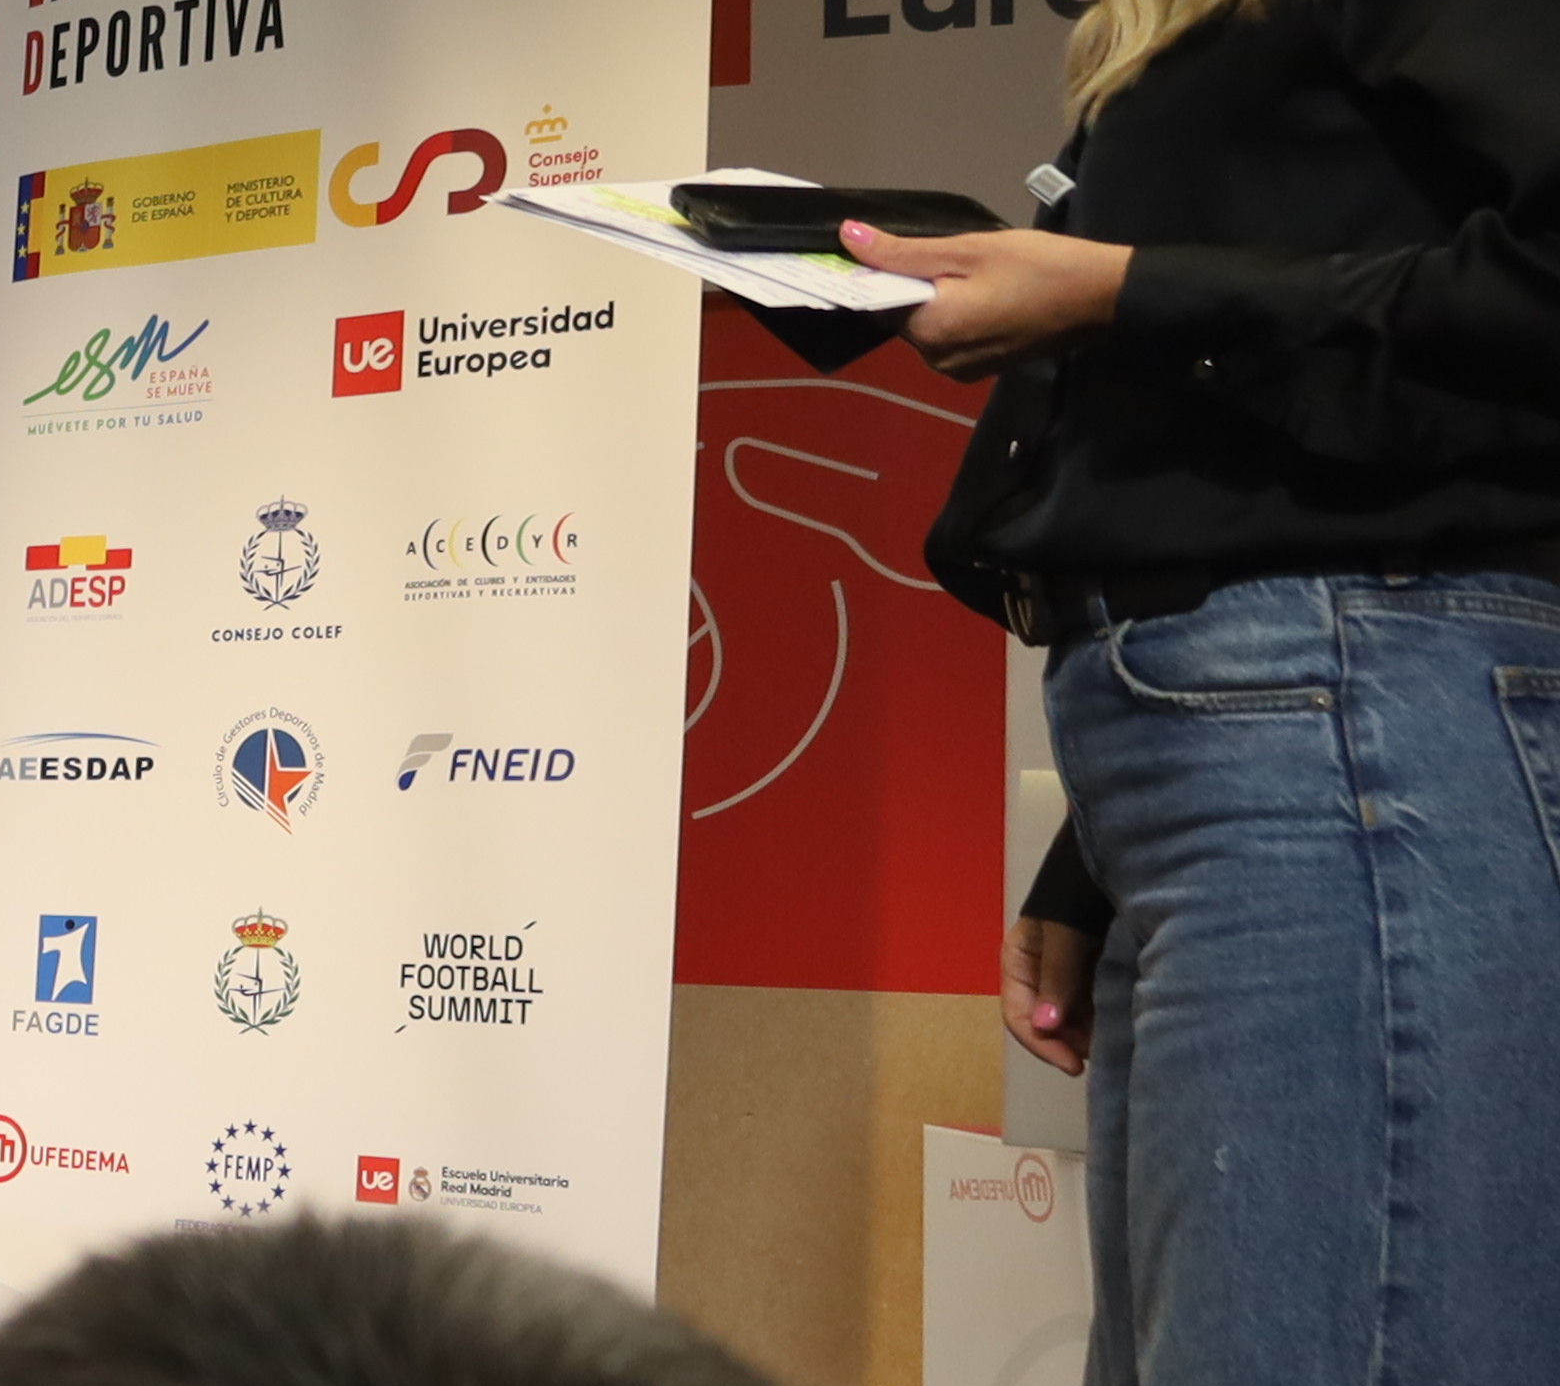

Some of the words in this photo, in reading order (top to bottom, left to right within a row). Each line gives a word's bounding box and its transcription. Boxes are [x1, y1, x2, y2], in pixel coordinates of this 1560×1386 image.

[528, 145, 599, 169] Consejo
[226, 174, 295, 194] MINISTERIO
[528, 166, 604, 187] Superior
[132, 190, 197, 209] GOBIERNO
[225, 195, 242, 208] DE
[246, 187, 303, 206] CULTURA
[131, 209, 149, 223] DE
[150, 203, 195, 221] ESPAÑA
[224, 210, 235, 222] Y
[237, 204, 291, 222] DEPORTE
[419, 300, 615, 345] Universidad
[149, 365, 210, 384] ESPAÑA
[417, 348, 551, 378] Europea
[146, 386, 161, 399] SE
[166, 381, 213, 397] MUEVE
[27, 416, 89, 436] MUÉVETE
[96, 417, 126, 430] POR
[134, 416, 150, 427] TU
[158, 410, 203, 425] SALUD
[457, 578, 468, 587] DE
[474, 576, 506, 586] CLUBES
[525, 574, 577, 584] ENTIDADES
[27, 575, 126, 610] ADESP
[403, 590, 471, 601] DEPORTIVAS
[491, 586, 577, 598] RECREATIVAS
[211, 627, 284, 643] CONSEJO
[291, 625, 343, 640] COLEF
[222, 709, 267, 744] Gestores
[269, 706, 321, 751] Deportivos
[215, 745, 227, 762] de
[314, 752, 325, 769] de
[448, 748, 576, 782] FNEID
[298, 772, 325, 817] Madrid
[423, 933, 523, 961] WORLD
[400, 963, 544, 994] FOOTBALL
[408, 994, 534, 1025] SUMMIT
[11, 1009, 100, 1037] FAGDE
[30, 1145, 130, 1174] UFEDEMA
[223, 1154, 275, 1183] FEMP
[441, 1166, 487, 1181] Escuela
[489, 1170, 569, 1189] Universitaria
[441, 1180, 467, 1193] Real
[469, 1182, 512, 1198] Madrid
[439, 1196, 498, 1210] UNIVERSIDAD
[500, 1201, 543, 1214] EUROPEA
